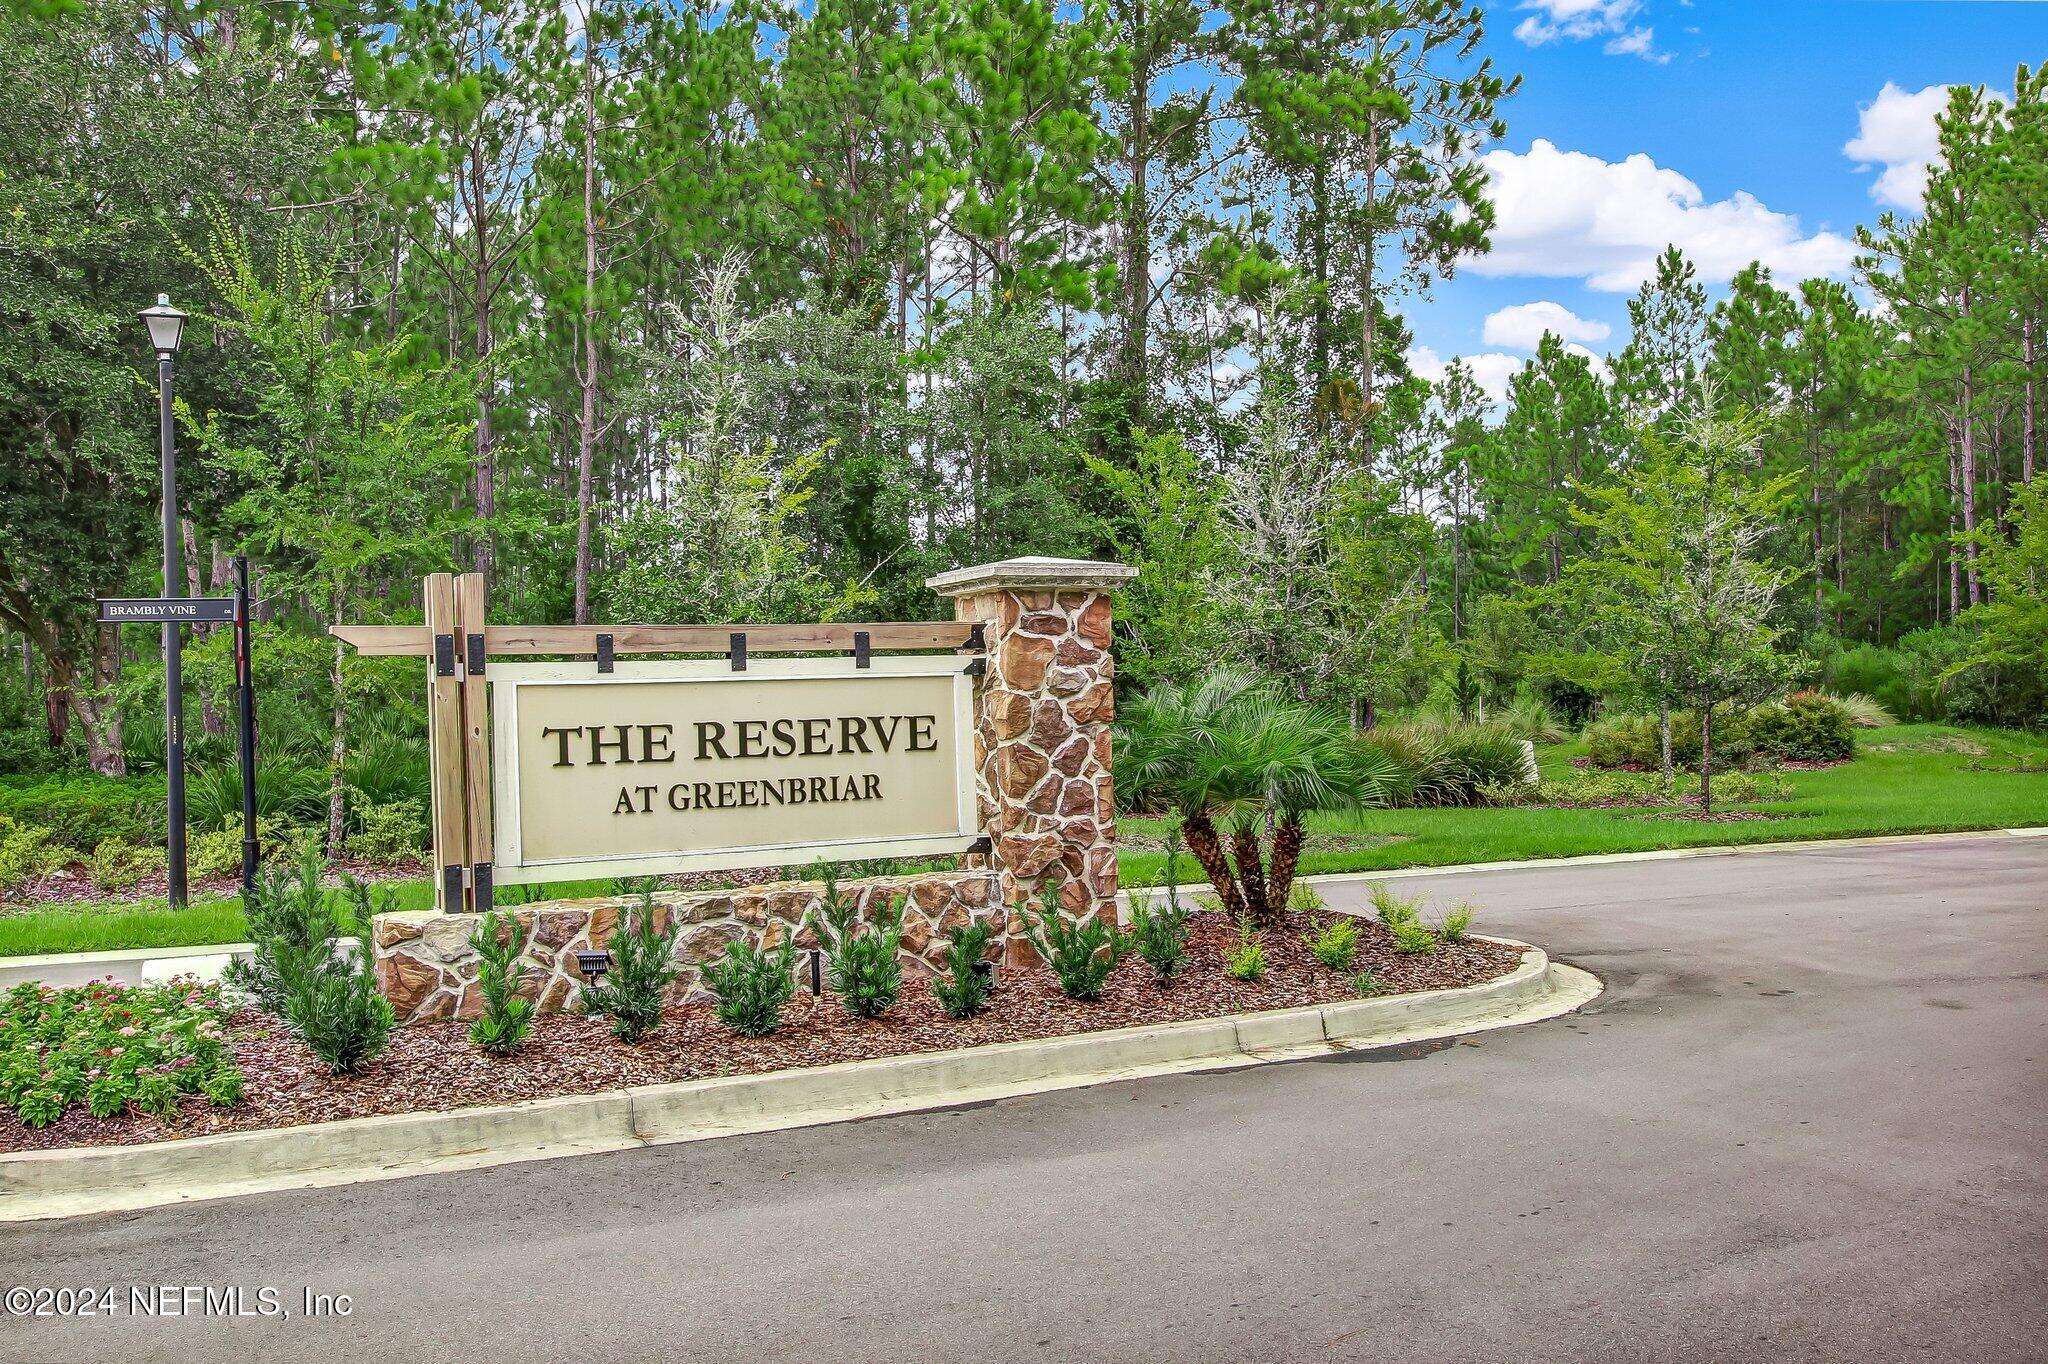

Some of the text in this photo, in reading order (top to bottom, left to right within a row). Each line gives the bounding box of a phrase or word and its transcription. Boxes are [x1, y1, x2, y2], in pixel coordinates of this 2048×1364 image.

[109, 606, 166, 616] BRAMBLY
[168, 605, 197, 615] VINE
[541, 714, 939, 768] THE RESERVE
[612, 772, 884, 815] AT GREENBRIAR
